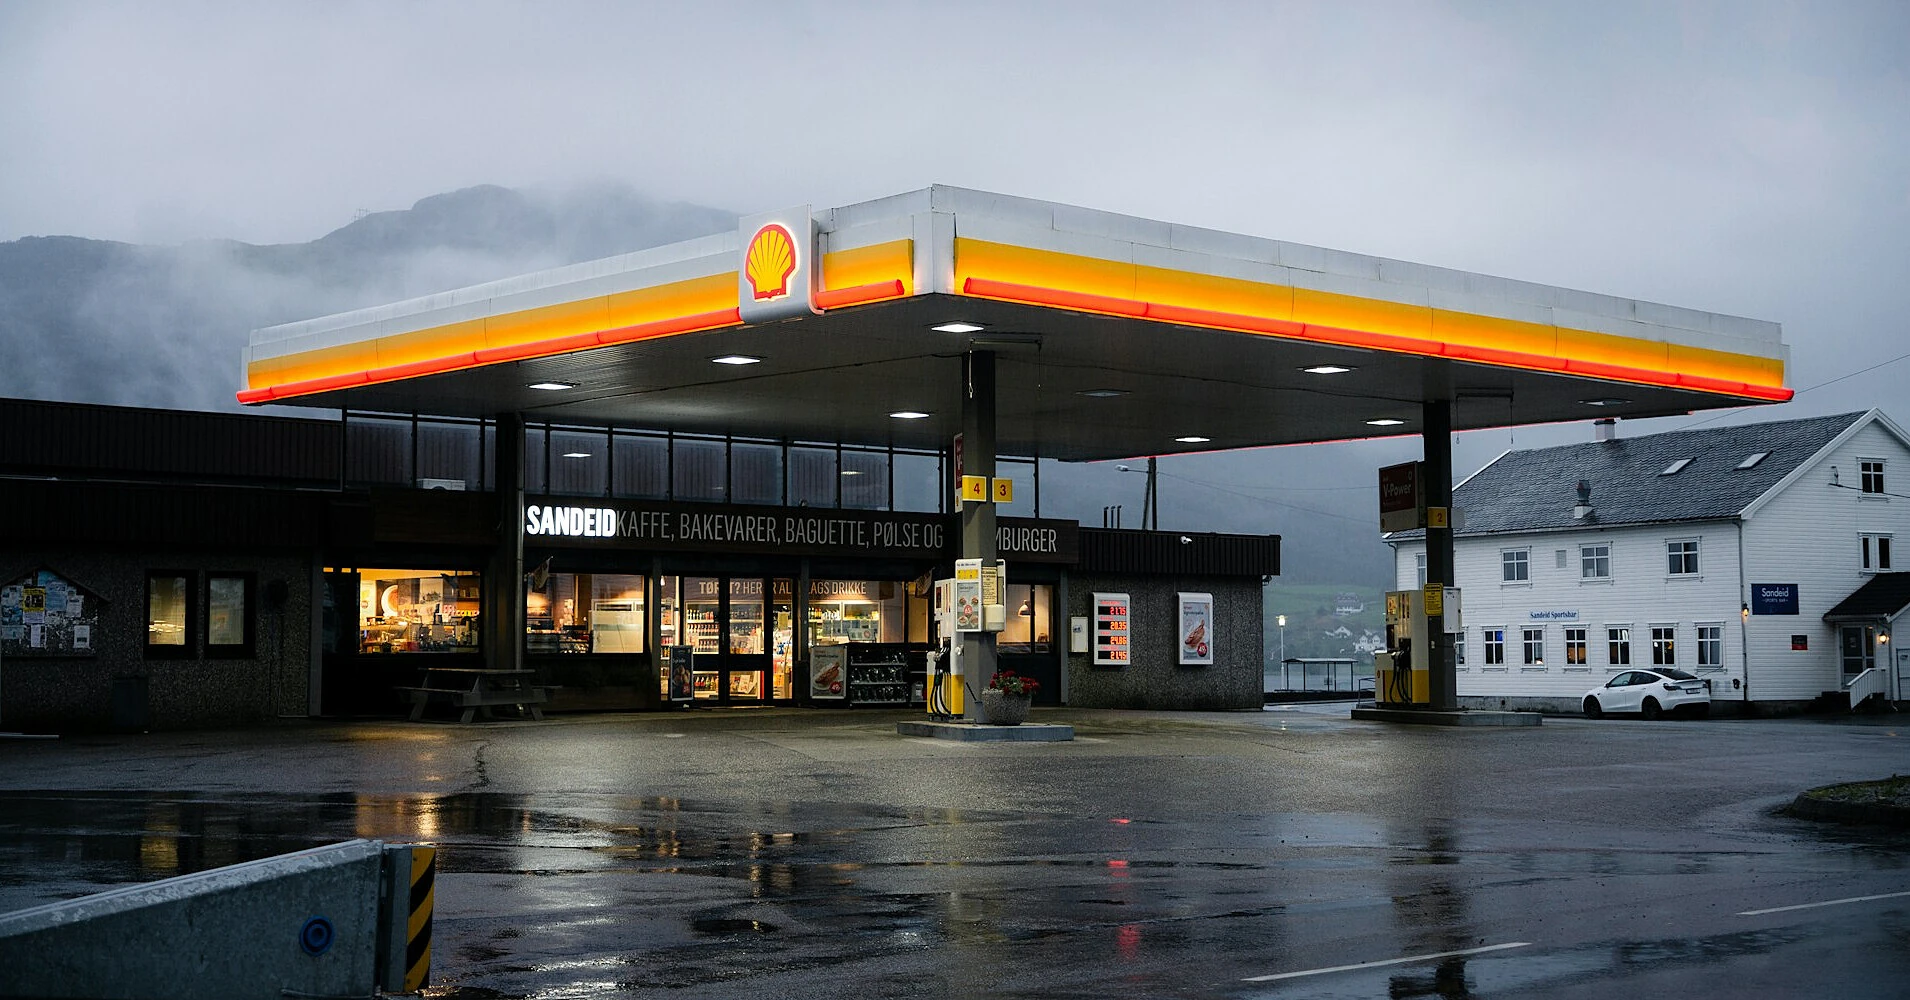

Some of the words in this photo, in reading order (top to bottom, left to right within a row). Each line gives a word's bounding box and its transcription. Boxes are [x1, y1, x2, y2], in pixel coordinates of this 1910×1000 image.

[973, 483, 980, 495] 4
[999, 484, 1007, 496] 3
[1383, 482, 1412, 498] V-Power
[526, 505, 617, 538] SANDEID
[1436, 512, 1443, 523] 2
[616, 510, 675, 542] KAFFE,
[679, 513, 781, 546] BAKEVARER,
[785, 518, 870, 549] BAGUETTE,
[873, 521, 920, 549] PØLSE
[924, 524, 943, 548] OG
[743, 581, 763, 595] HER
[831, 581, 867, 595] DRIKKE
[1761, 586, 1789, 598] Sandeid
[1530, 611, 1550, 619] Sandeid
[1551, 611, 1577, 620] Sportsbar
